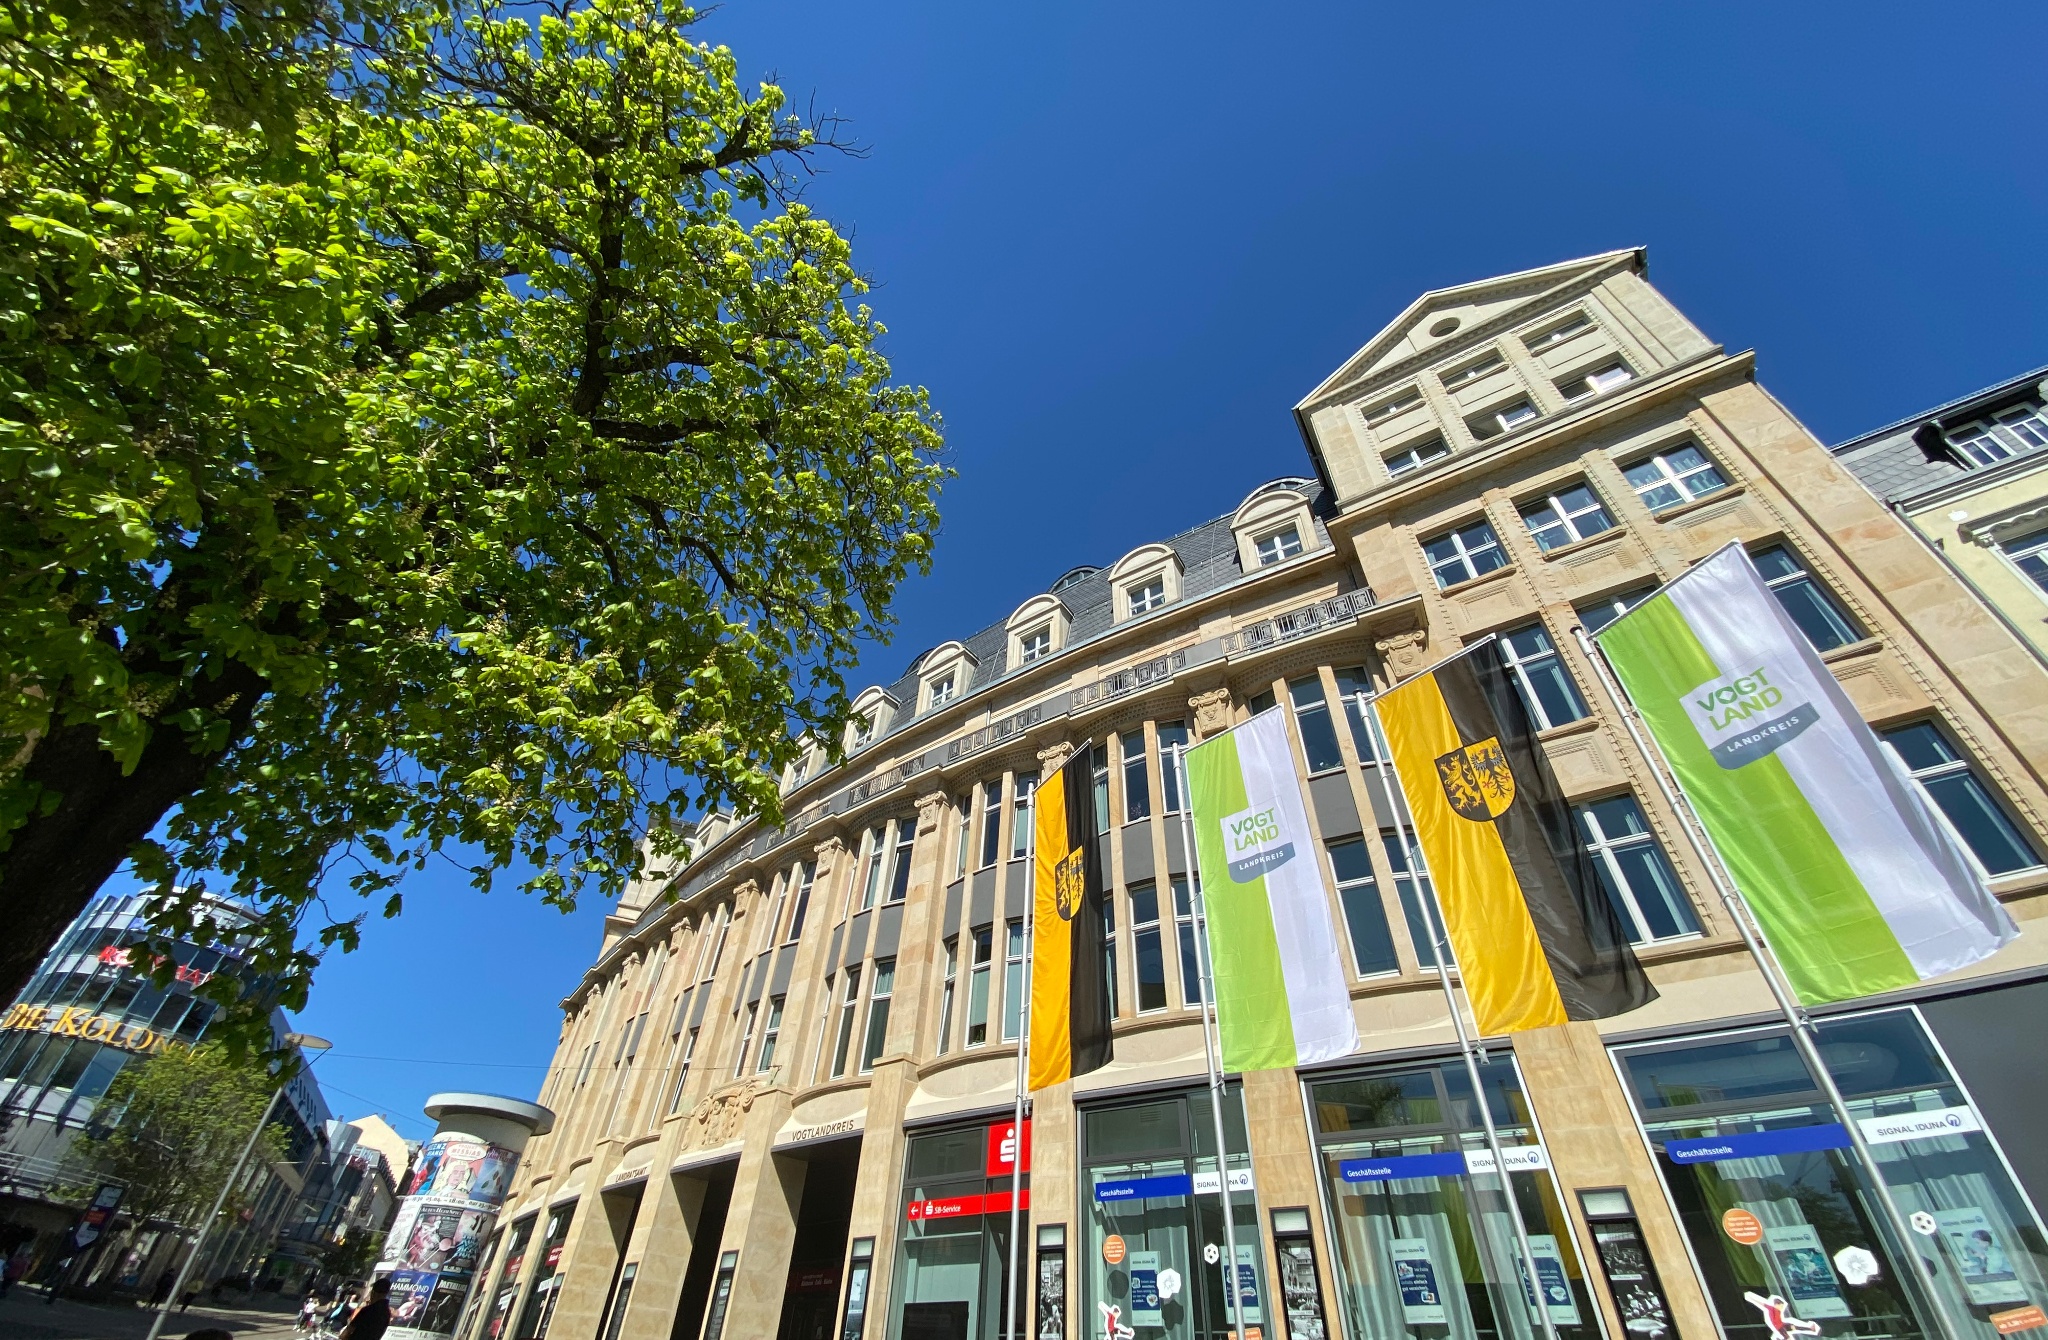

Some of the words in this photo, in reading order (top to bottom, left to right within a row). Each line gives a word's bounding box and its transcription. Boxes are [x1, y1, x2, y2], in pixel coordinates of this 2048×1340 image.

[1696, 666, 1769, 712] VOGT
[1708, 686, 1783, 731] LAND
[1726, 716, 1800, 753] LANDKREIS
[1230, 807, 1275, 835] VOGT
[1234, 824, 1279, 851] LAND
[1239, 850, 1284, 871] LANDKREIS
[1, 1003, 50, 1030] DIE
[792, 1119, 854, 1141] VOGTLANDKREIS
[1876, 1124, 1913, 1136] SIGNAL
[1914, 1121, 1948, 1132] IDUNA
[1471, 1158, 1496, 1167] SIGNA
[1505, 1156, 1528, 1165] DUNA
[1676, 1145, 1733, 1158] Geschäftsstelle
[1347, 1167, 1392, 1178] Geschäftsstelle
[1100, 1187, 1134, 1197] Geschäftsstelle
[934, 1204, 962, 1214] SB-Service
[390, 1282, 430, 1293] HAMMOND
